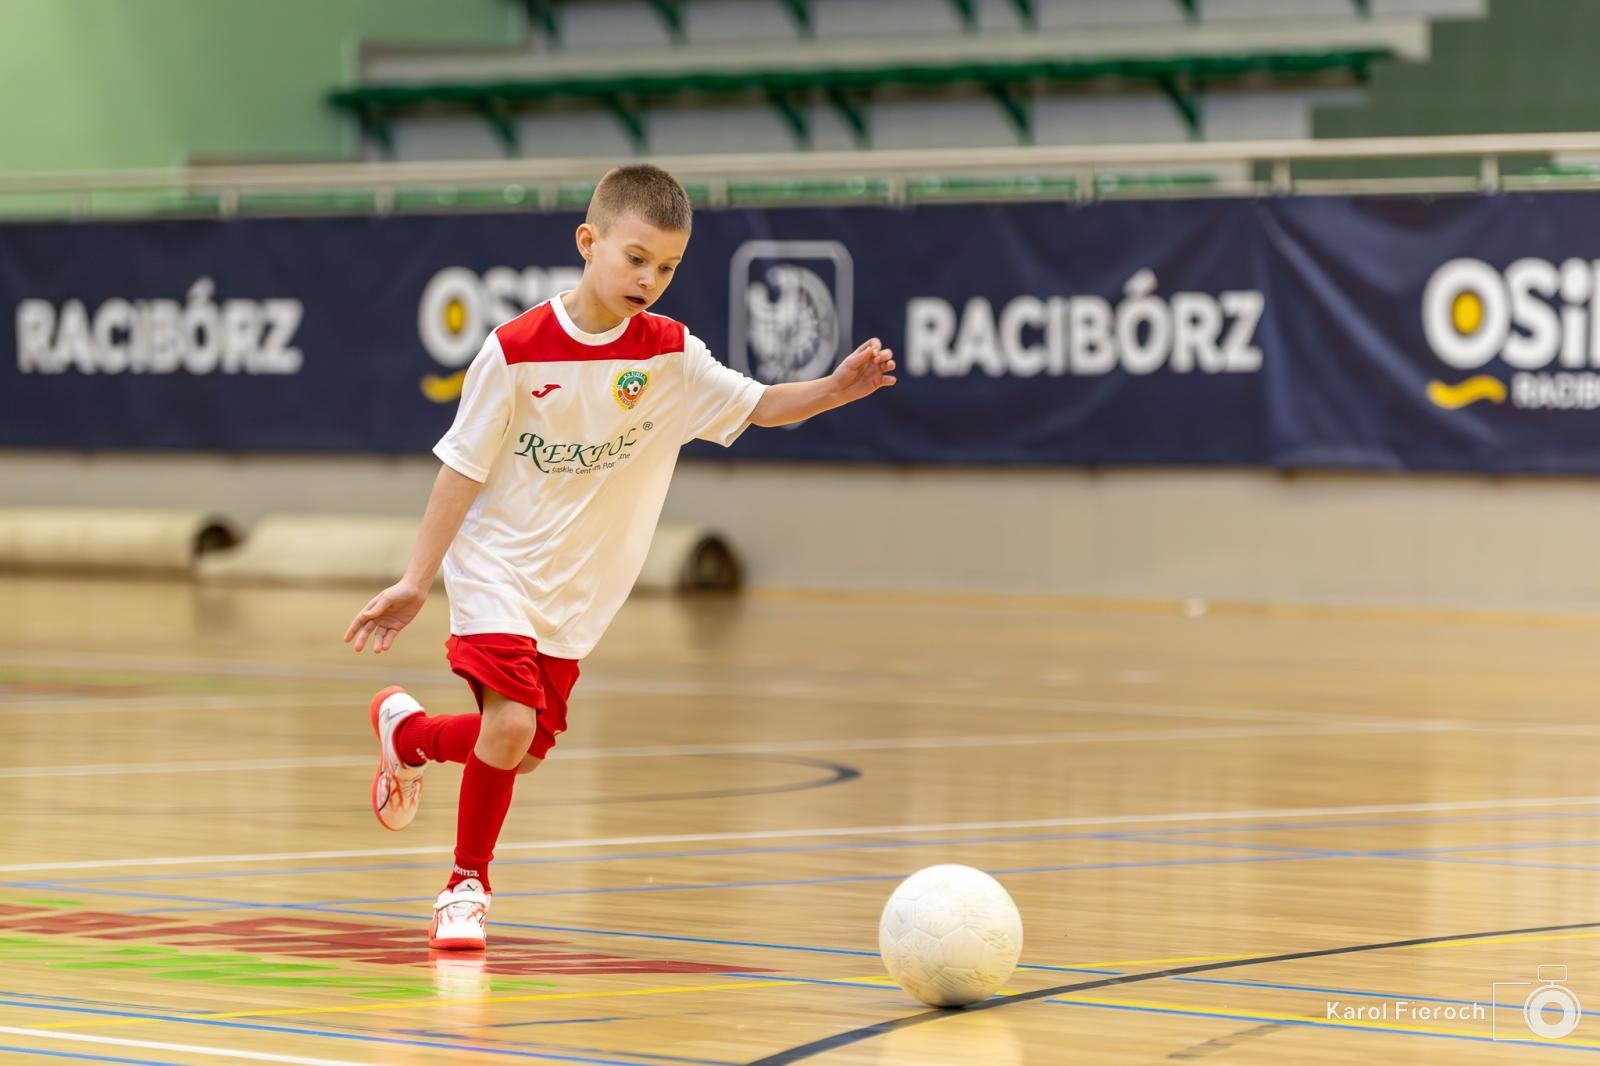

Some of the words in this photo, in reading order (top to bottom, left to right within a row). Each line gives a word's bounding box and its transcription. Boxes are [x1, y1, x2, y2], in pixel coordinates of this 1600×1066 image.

[15, 277, 304, 375] RACIBÓRZ
[905, 267, 1265, 377] RACIBÓRZ
[1421, 257, 1600, 370] OSi
